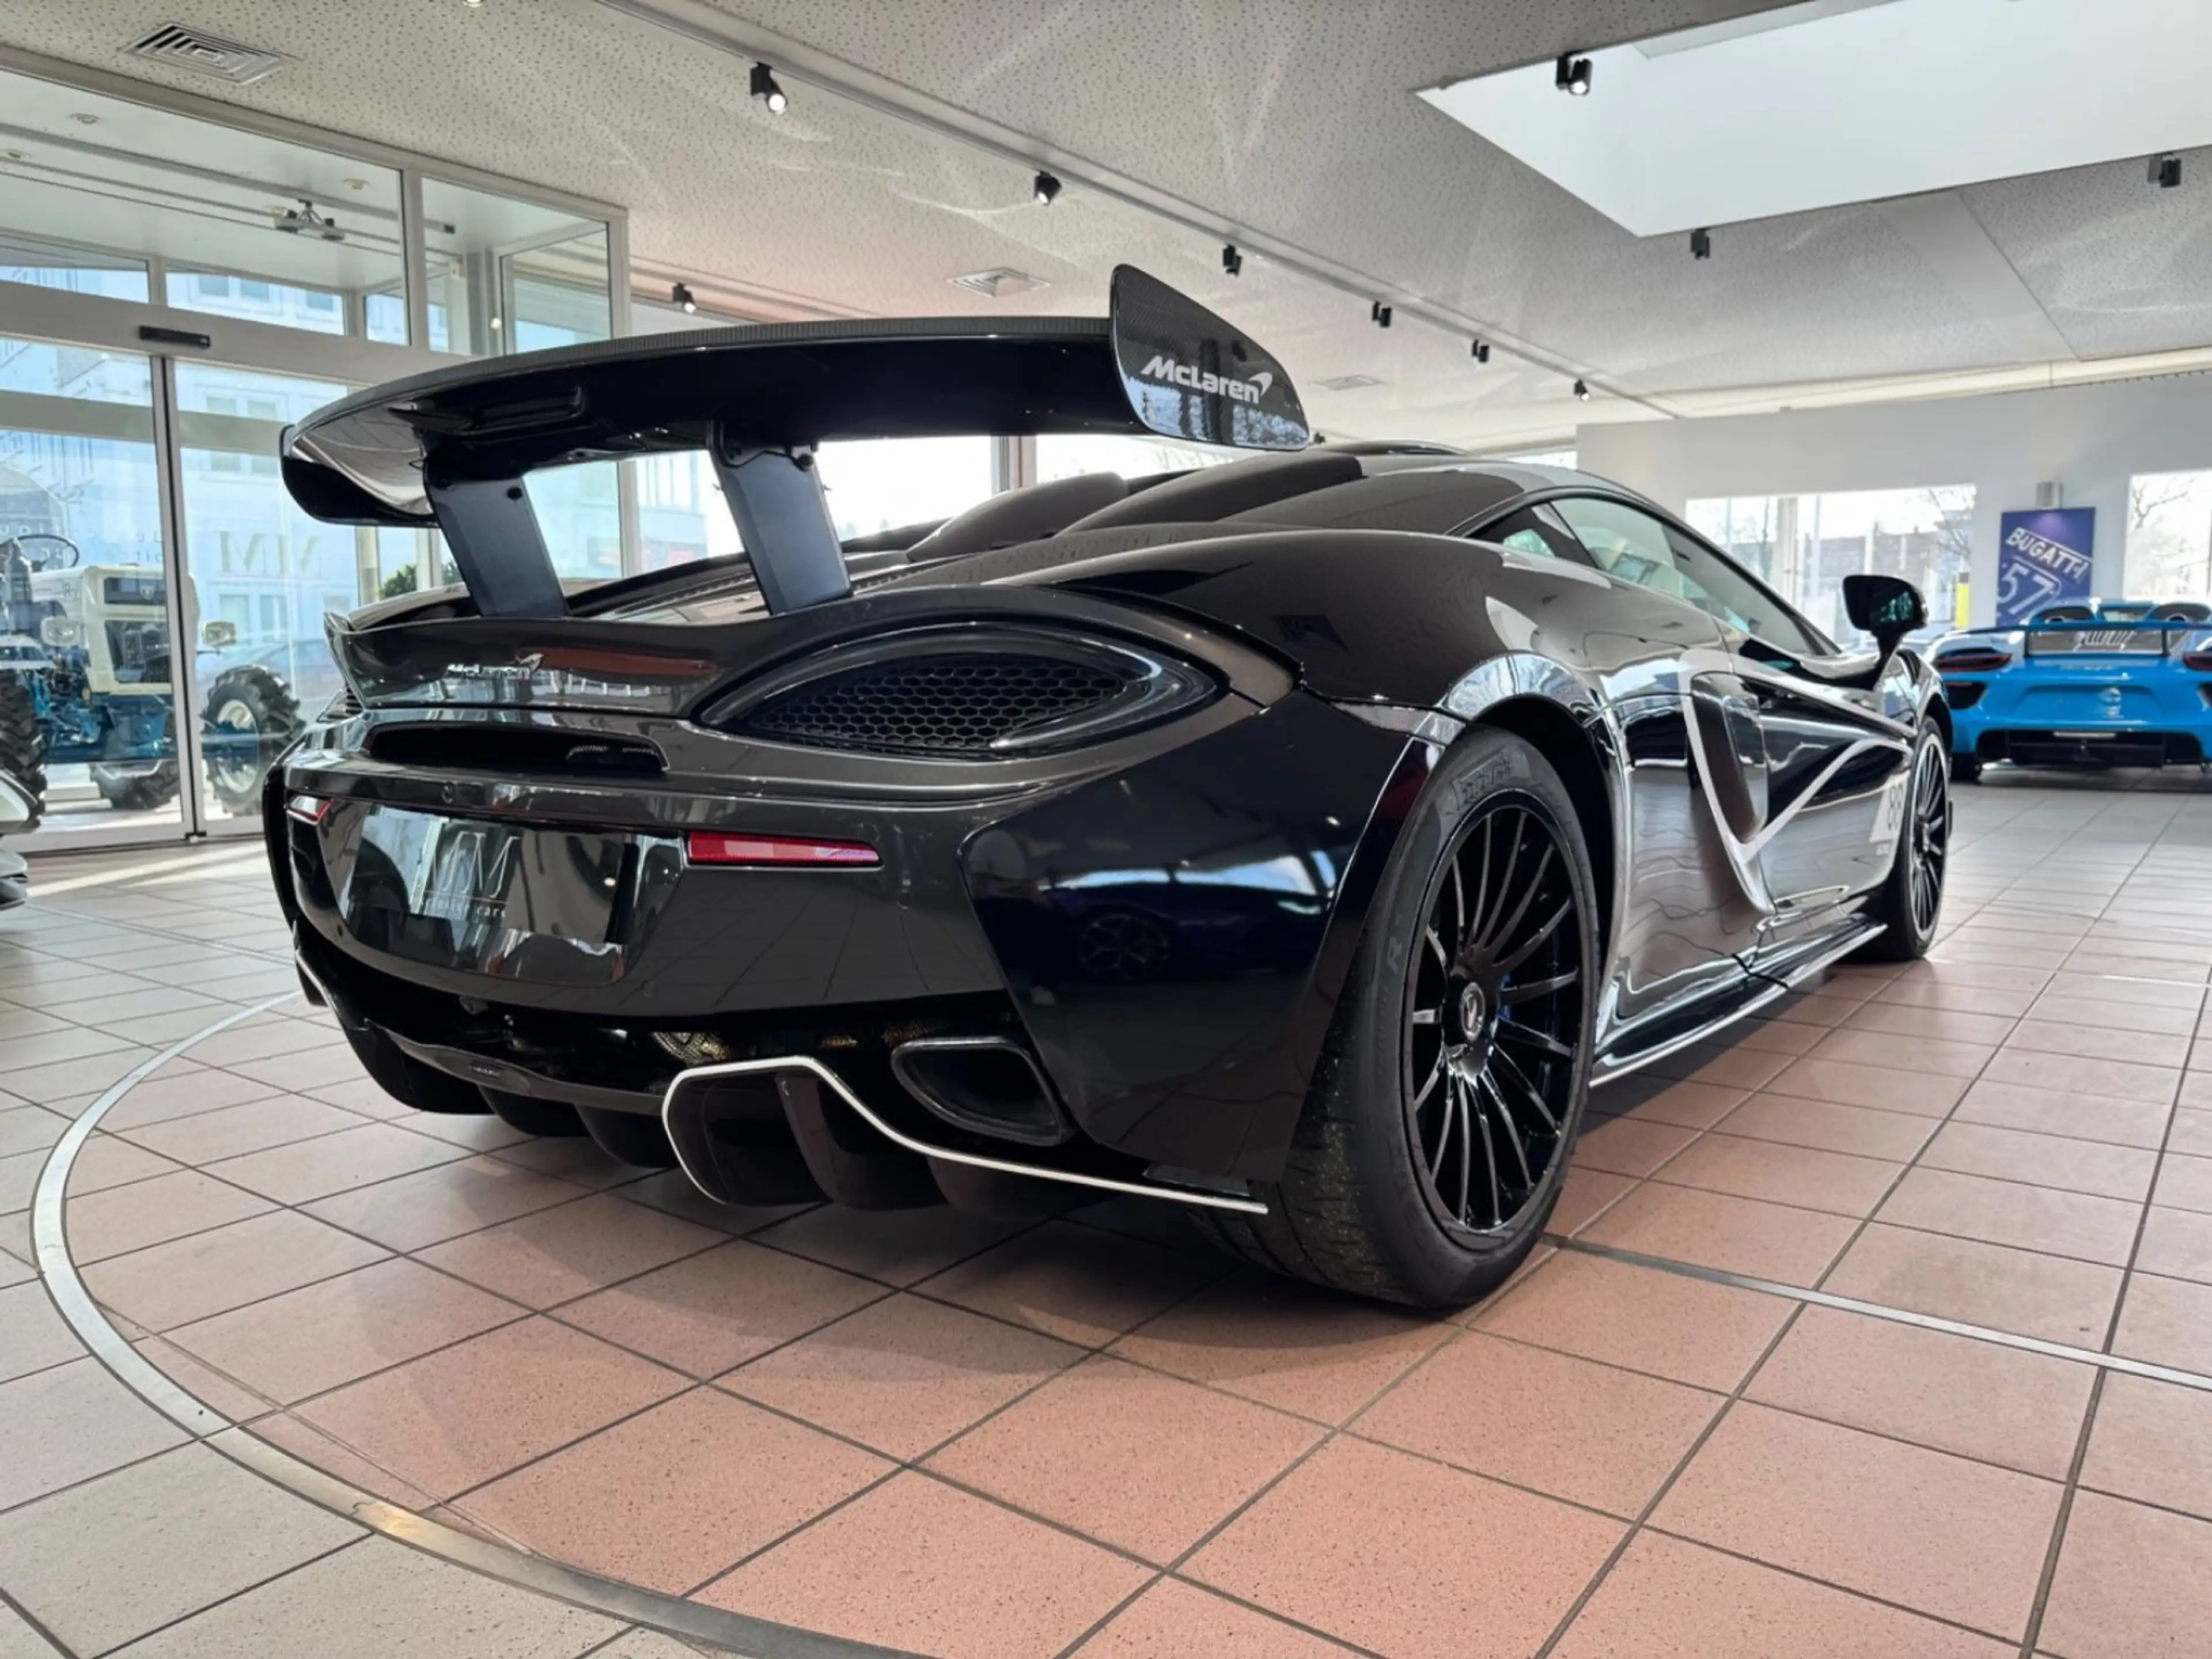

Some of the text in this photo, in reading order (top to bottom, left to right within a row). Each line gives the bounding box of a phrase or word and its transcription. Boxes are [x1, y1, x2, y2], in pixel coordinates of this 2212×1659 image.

[1141, 355, 1260, 403] McLaren
[2005, 527, 2089, 579] BUGATTI
[1997, 563, 2055, 615] 57
